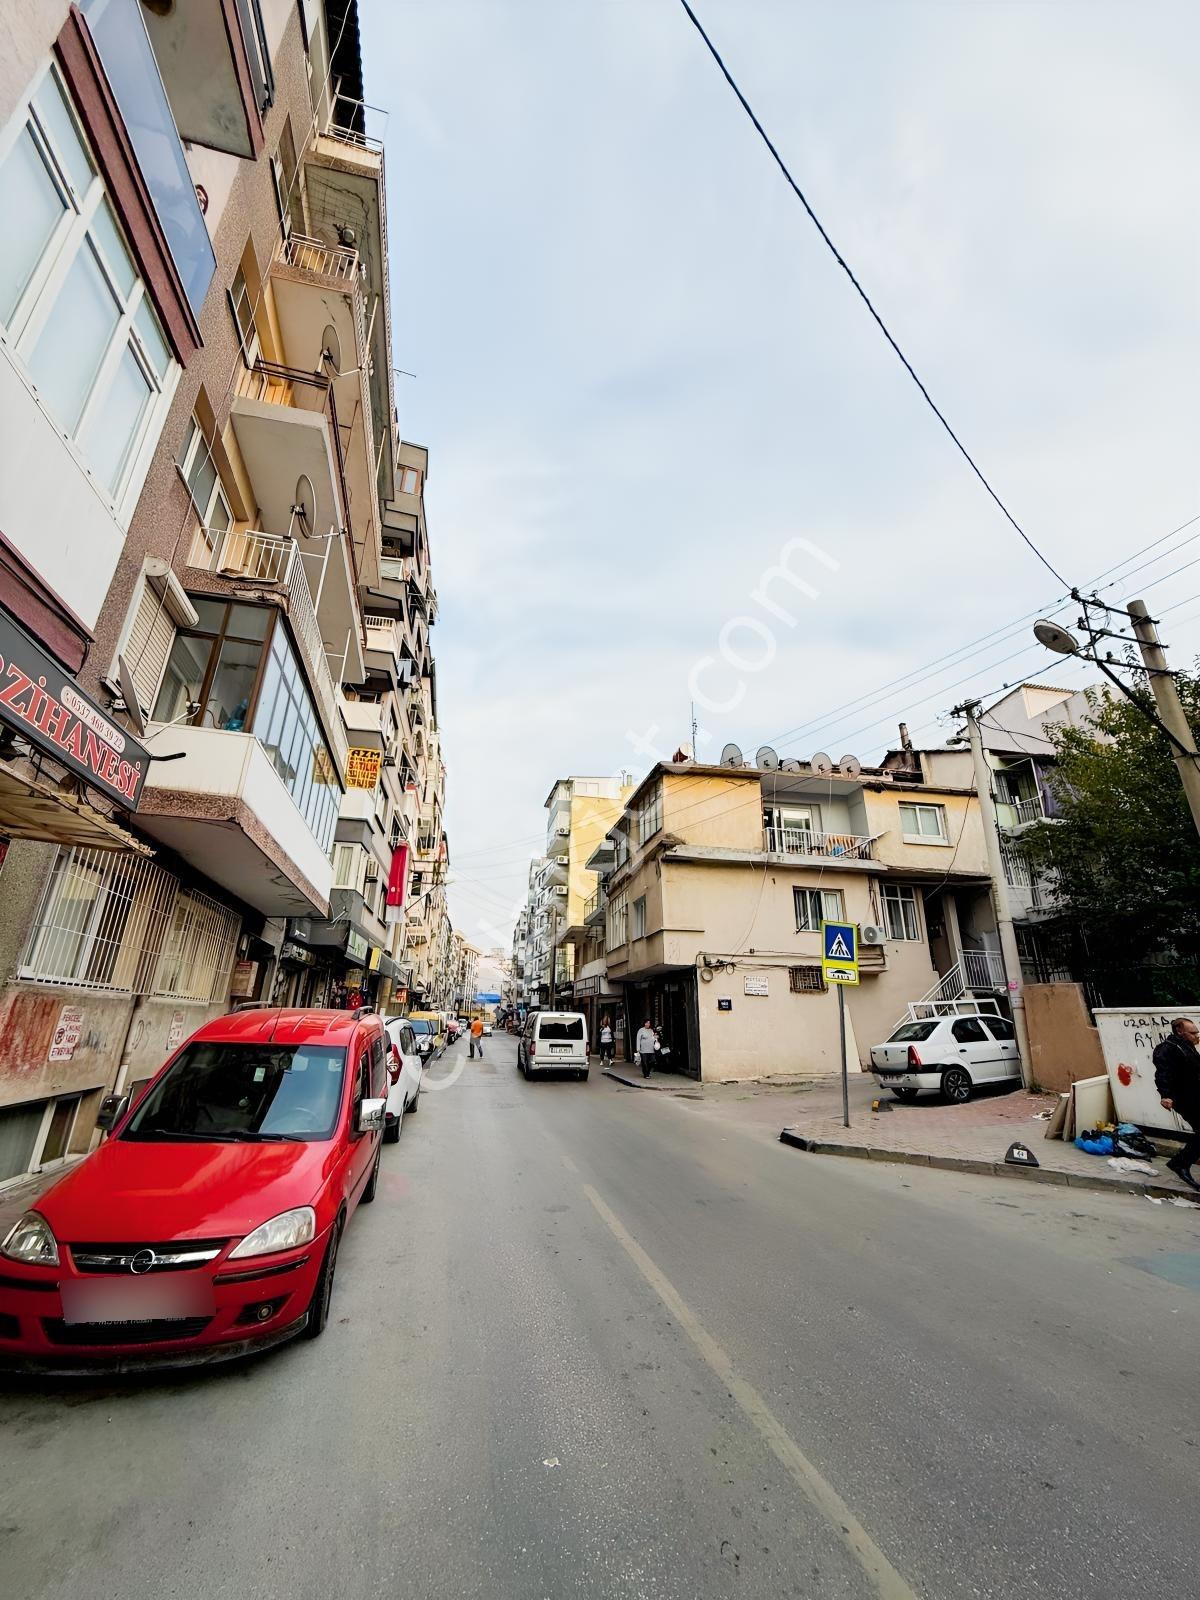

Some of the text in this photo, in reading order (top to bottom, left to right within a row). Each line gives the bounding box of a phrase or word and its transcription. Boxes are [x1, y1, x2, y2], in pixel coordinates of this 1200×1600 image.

[0, 654, 140, 801] ZİHANESİ
[113, 735, 123, 749] 22
[351, 750, 381, 759] AZM
